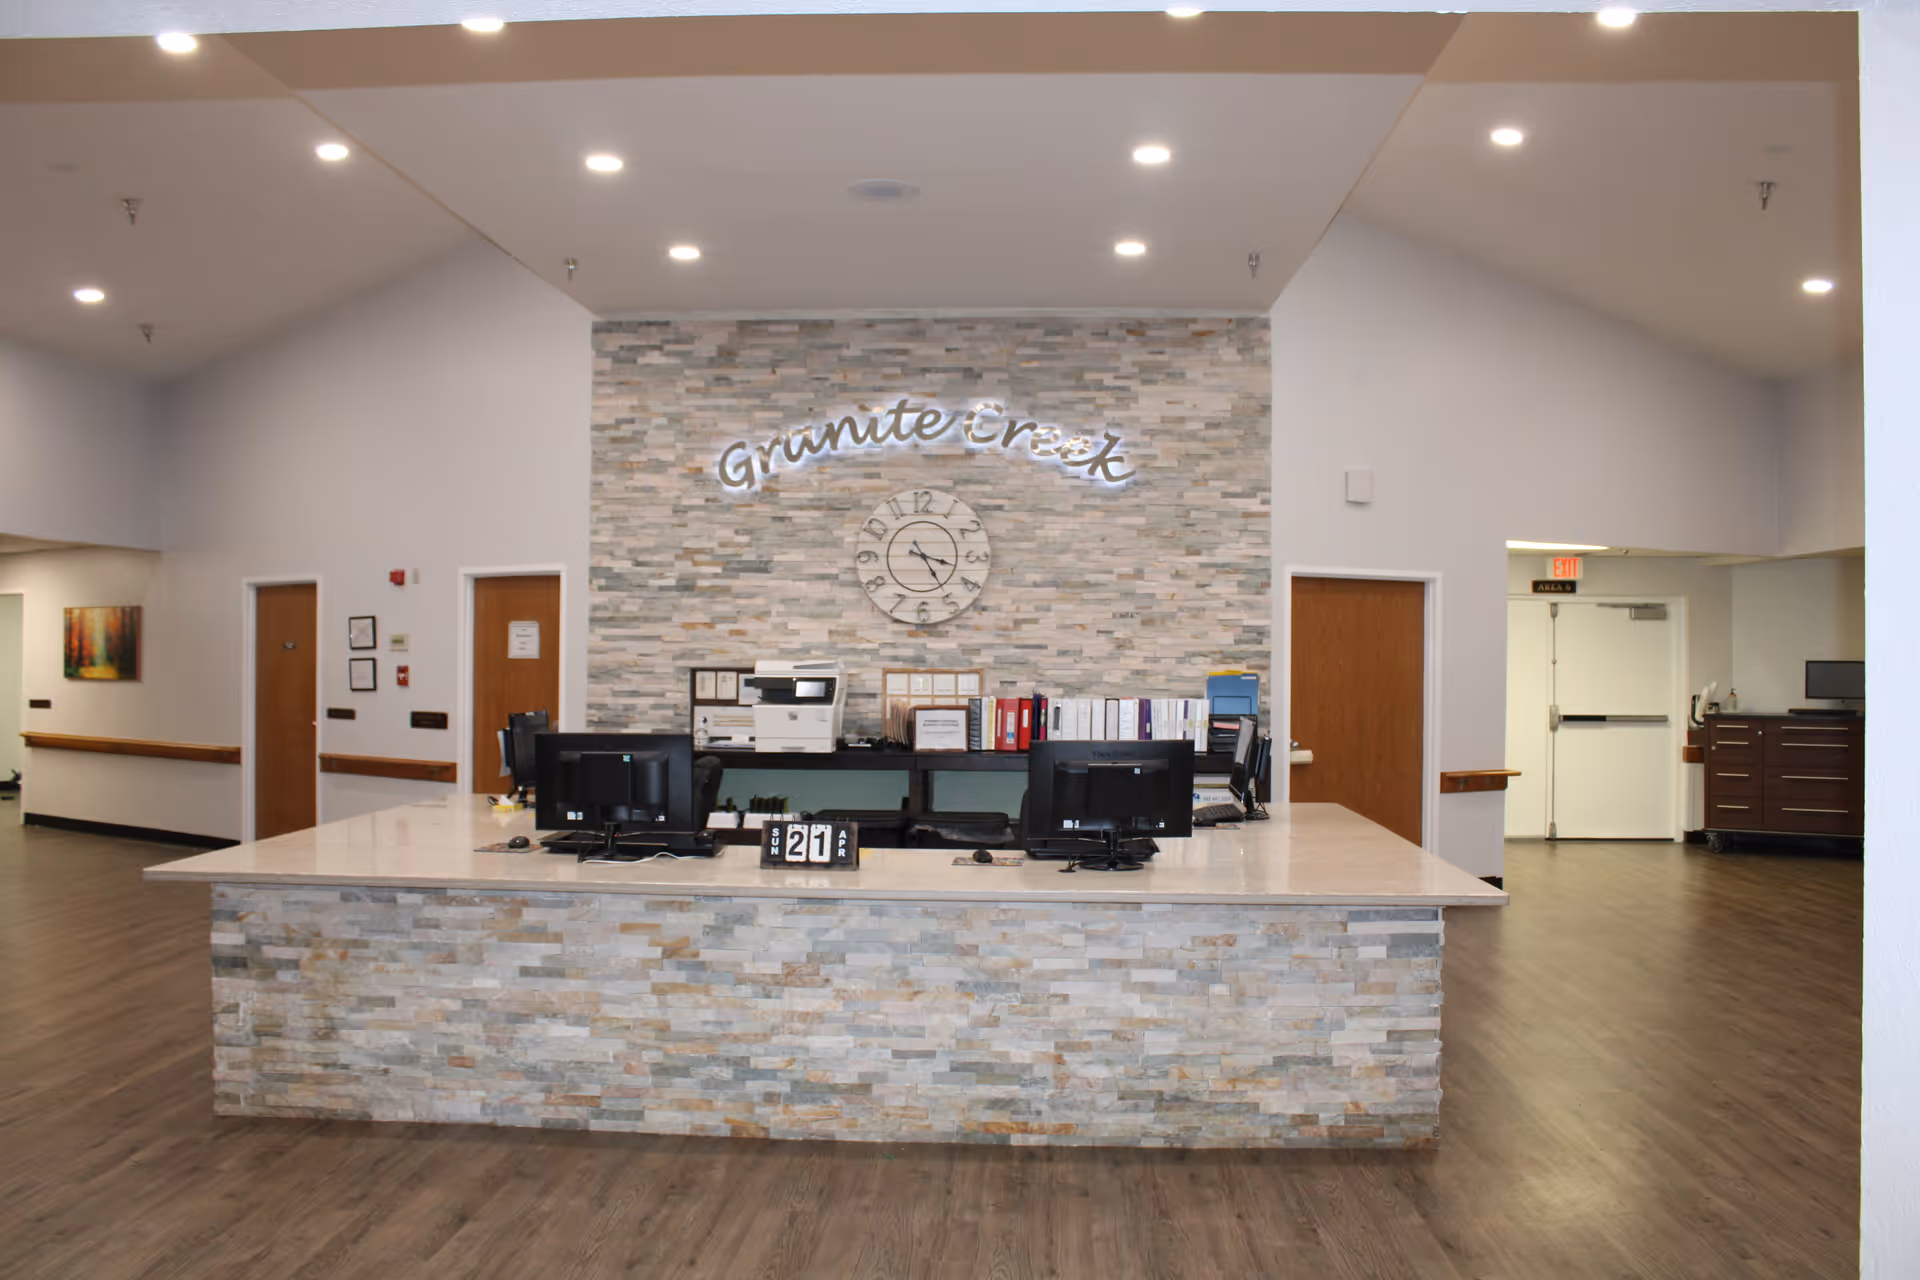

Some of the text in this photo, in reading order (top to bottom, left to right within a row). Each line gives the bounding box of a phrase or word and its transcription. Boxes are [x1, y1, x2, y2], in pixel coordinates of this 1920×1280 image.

[718, 399, 1137, 490] Granite Creek
[913, 490, 933, 513] 12
[943, 498, 958, 519] 1
[863, 517, 888, 541] 10
[960, 519, 981, 540] 2
[856, 550, 879, 564] 9
[965, 550, 989, 564] 3
[1553, 557, 1579, 578] EXIT
[865, 575, 886, 593] 8
[960, 576, 981, 593] 4
[889, 592, 906, 614] 7
[917, 601, 930, 622] 6
[942, 592, 960, 614] 5
[771, 828, 780, 855] SUN
[788, 831, 825, 857] 21
[838, 830, 847, 857] APR
